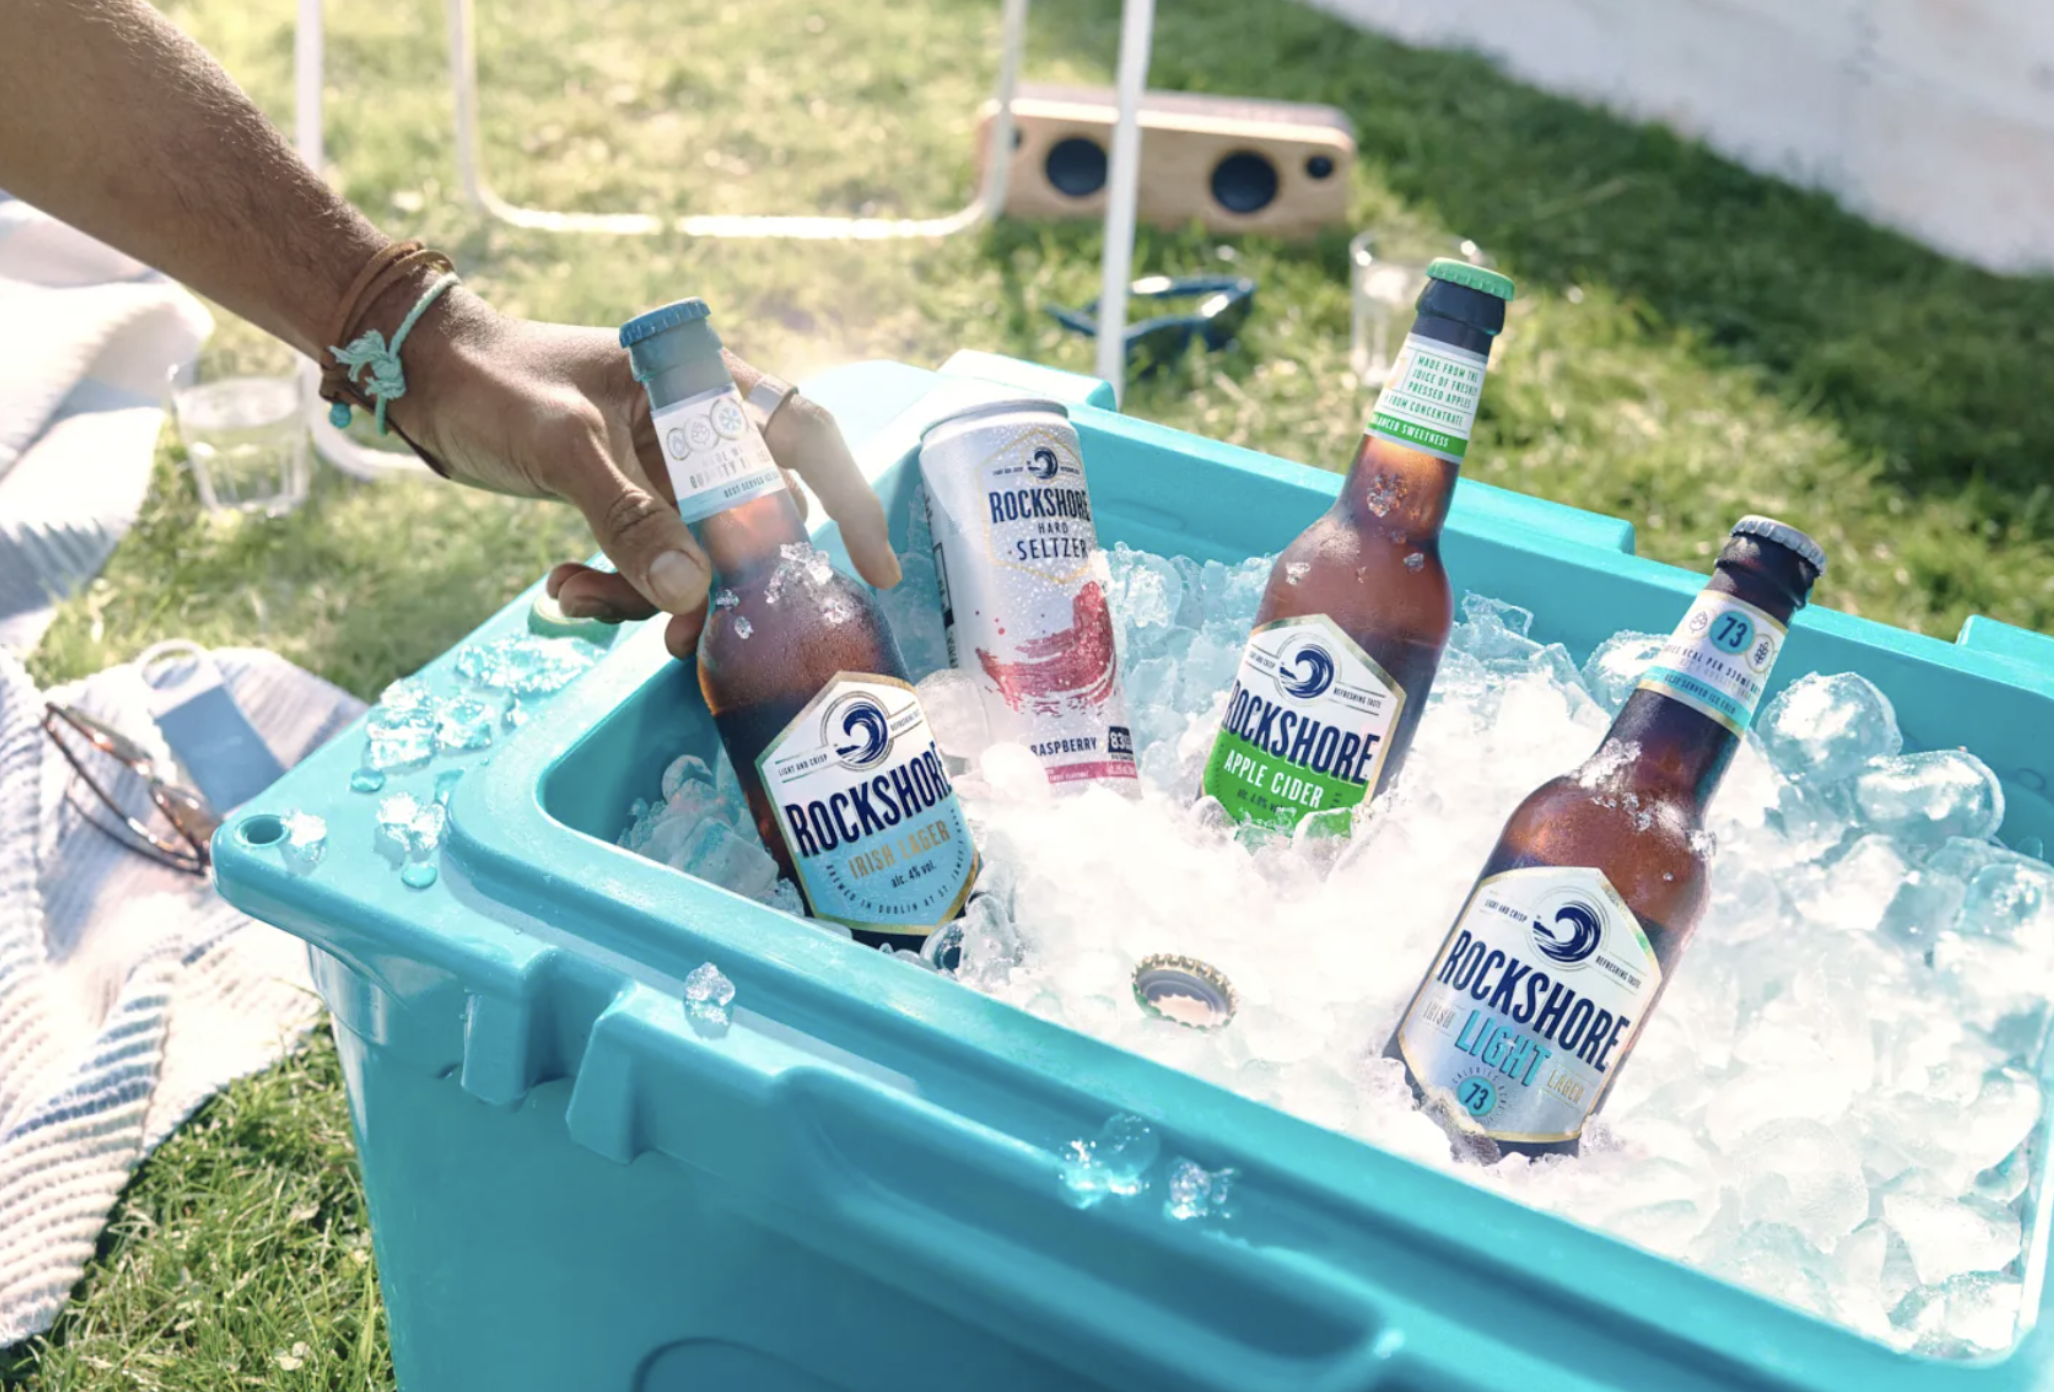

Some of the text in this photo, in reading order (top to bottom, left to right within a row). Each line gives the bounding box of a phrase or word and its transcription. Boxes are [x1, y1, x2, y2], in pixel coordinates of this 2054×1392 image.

[1412, 368, 1436, 384] JUICE
[1438, 376, 1449, 388] OF
[1418, 356, 1440, 372] MADE
[1443, 363, 1466, 377] FROM
[1407, 381, 1444, 401] PRESSED
[1409, 401, 1464, 427] CONCENTRATE
[1402, 424, 1449, 448] SWEETNESS
[988, 488, 1091, 523] ROCKSHORE
[1037, 522, 1069, 534] HARD
[1016, 538, 1089, 561] SELTZER
[1717, 616, 1748, 648] 73
[1110, 730, 1126, 750] 83
[1224, 679, 1381, 786] ROCKSHORE
[1030, 736, 1097, 758] RASPBERRY
[809, 753, 828, 767] CRISP
[1224, 749, 1268, 788] APPLE
[1271, 772, 1324, 808] CIDER
[848, 842, 897, 880] IRISH
[898, 820, 951, 861] LAGER
[909, 865, 921, 882] 4%
[921, 860, 938, 876] vol.
[825, 864, 856, 902] BREWED
[860, 899, 872, 909] IN
[878, 904, 919, 915] DUBLIN
[924, 895, 936, 907] AT
[1510, 908, 1528, 924] CRISP
[1595, 955, 1628, 980] REFRESHING
[1437, 929, 1631, 1074] ROCKSHORE
[1423, 1000, 1456, 1030] IRISH
[1454, 1009, 1552, 1087] LIGHT
[1547, 1070, 1585, 1104] LAGER
[1465, 1082, 1489, 1111] 73
